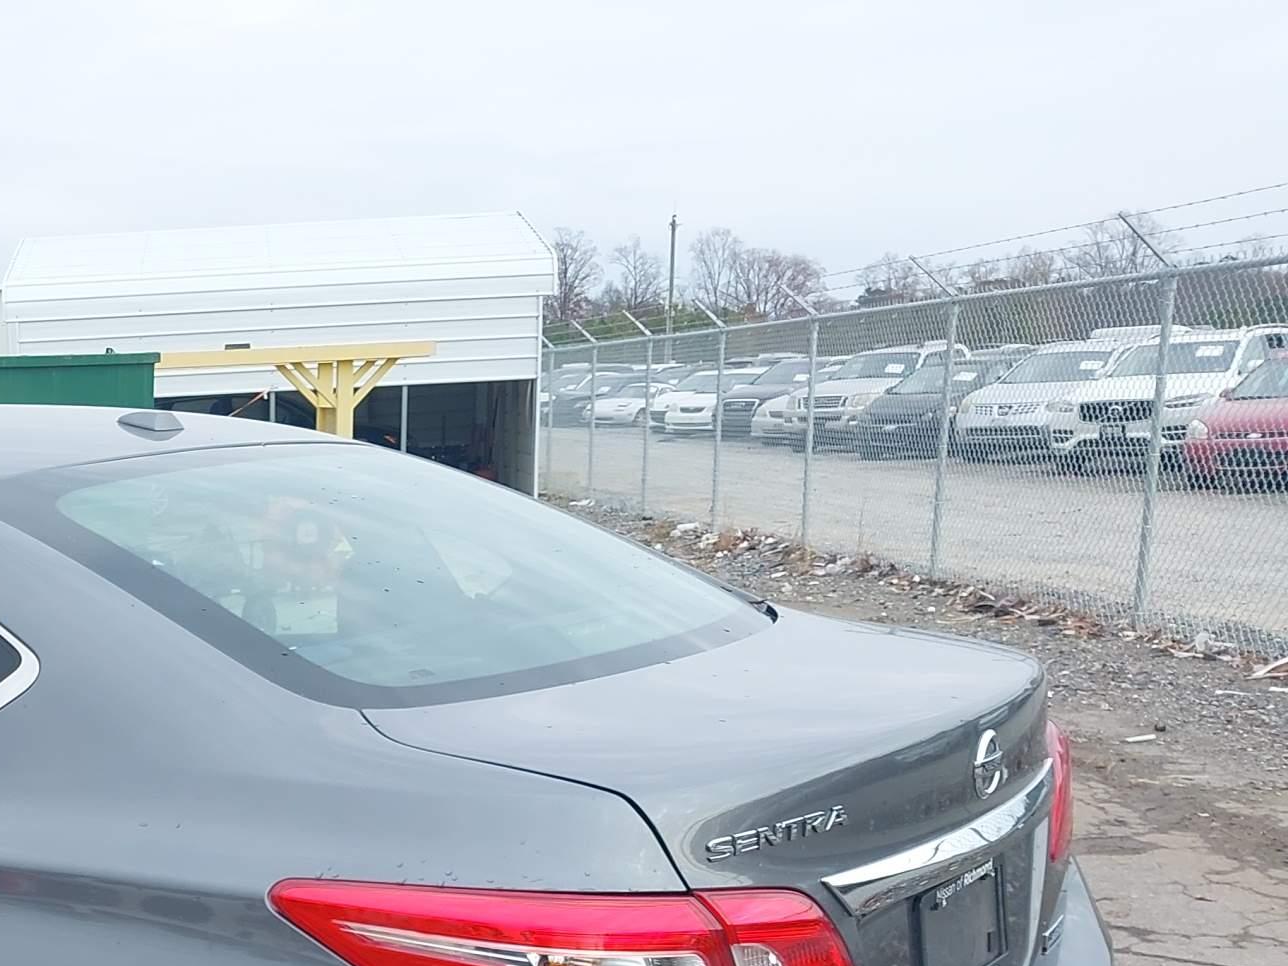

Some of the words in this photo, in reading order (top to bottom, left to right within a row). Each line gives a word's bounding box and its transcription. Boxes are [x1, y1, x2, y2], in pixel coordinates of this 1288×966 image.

[705, 804, 848, 863] SENTRA
[936, 883, 956, 903] Nissan
[963, 857, 993, 887] Richmond
